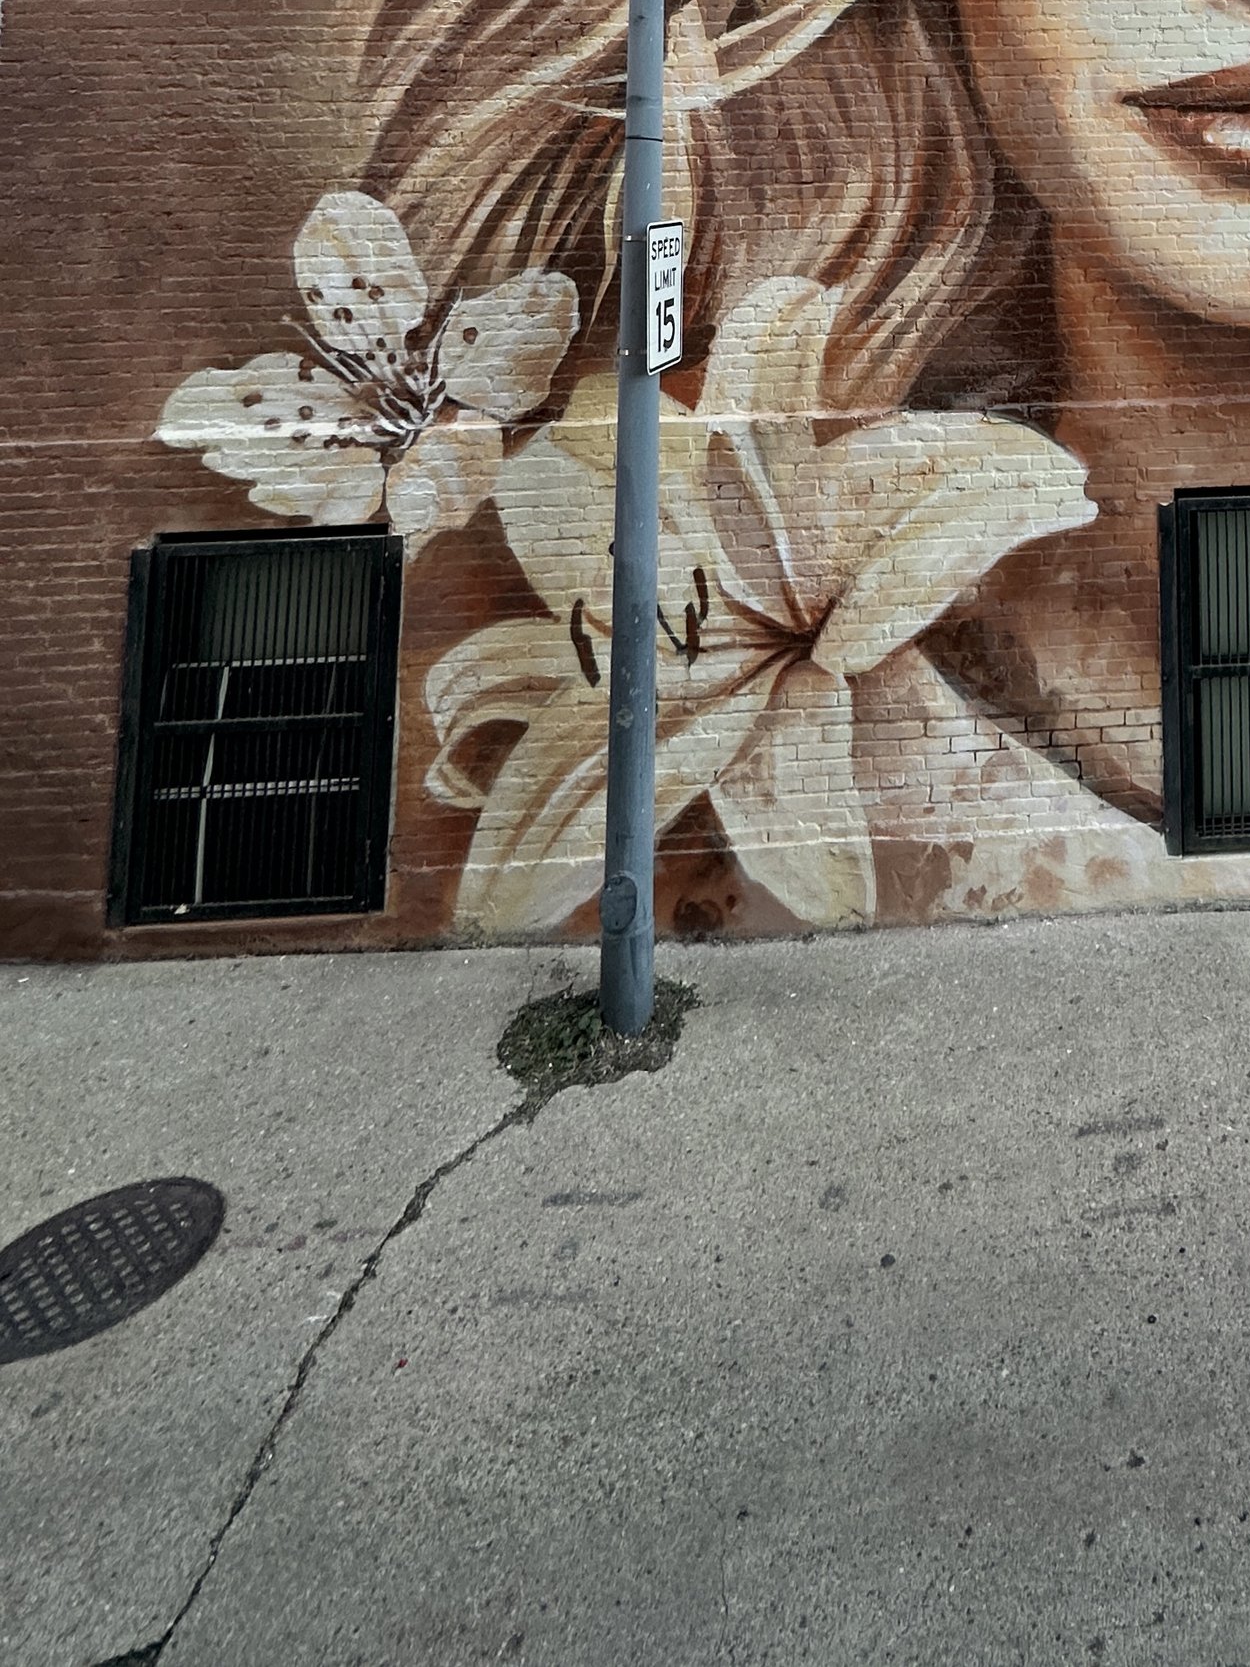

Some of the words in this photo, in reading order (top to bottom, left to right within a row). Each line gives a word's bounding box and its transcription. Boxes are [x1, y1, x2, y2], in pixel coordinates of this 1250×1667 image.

[651, 237, 681, 261] SPEED
[654, 267, 677, 292] LIMIT
[656, 297, 676, 353] 15
